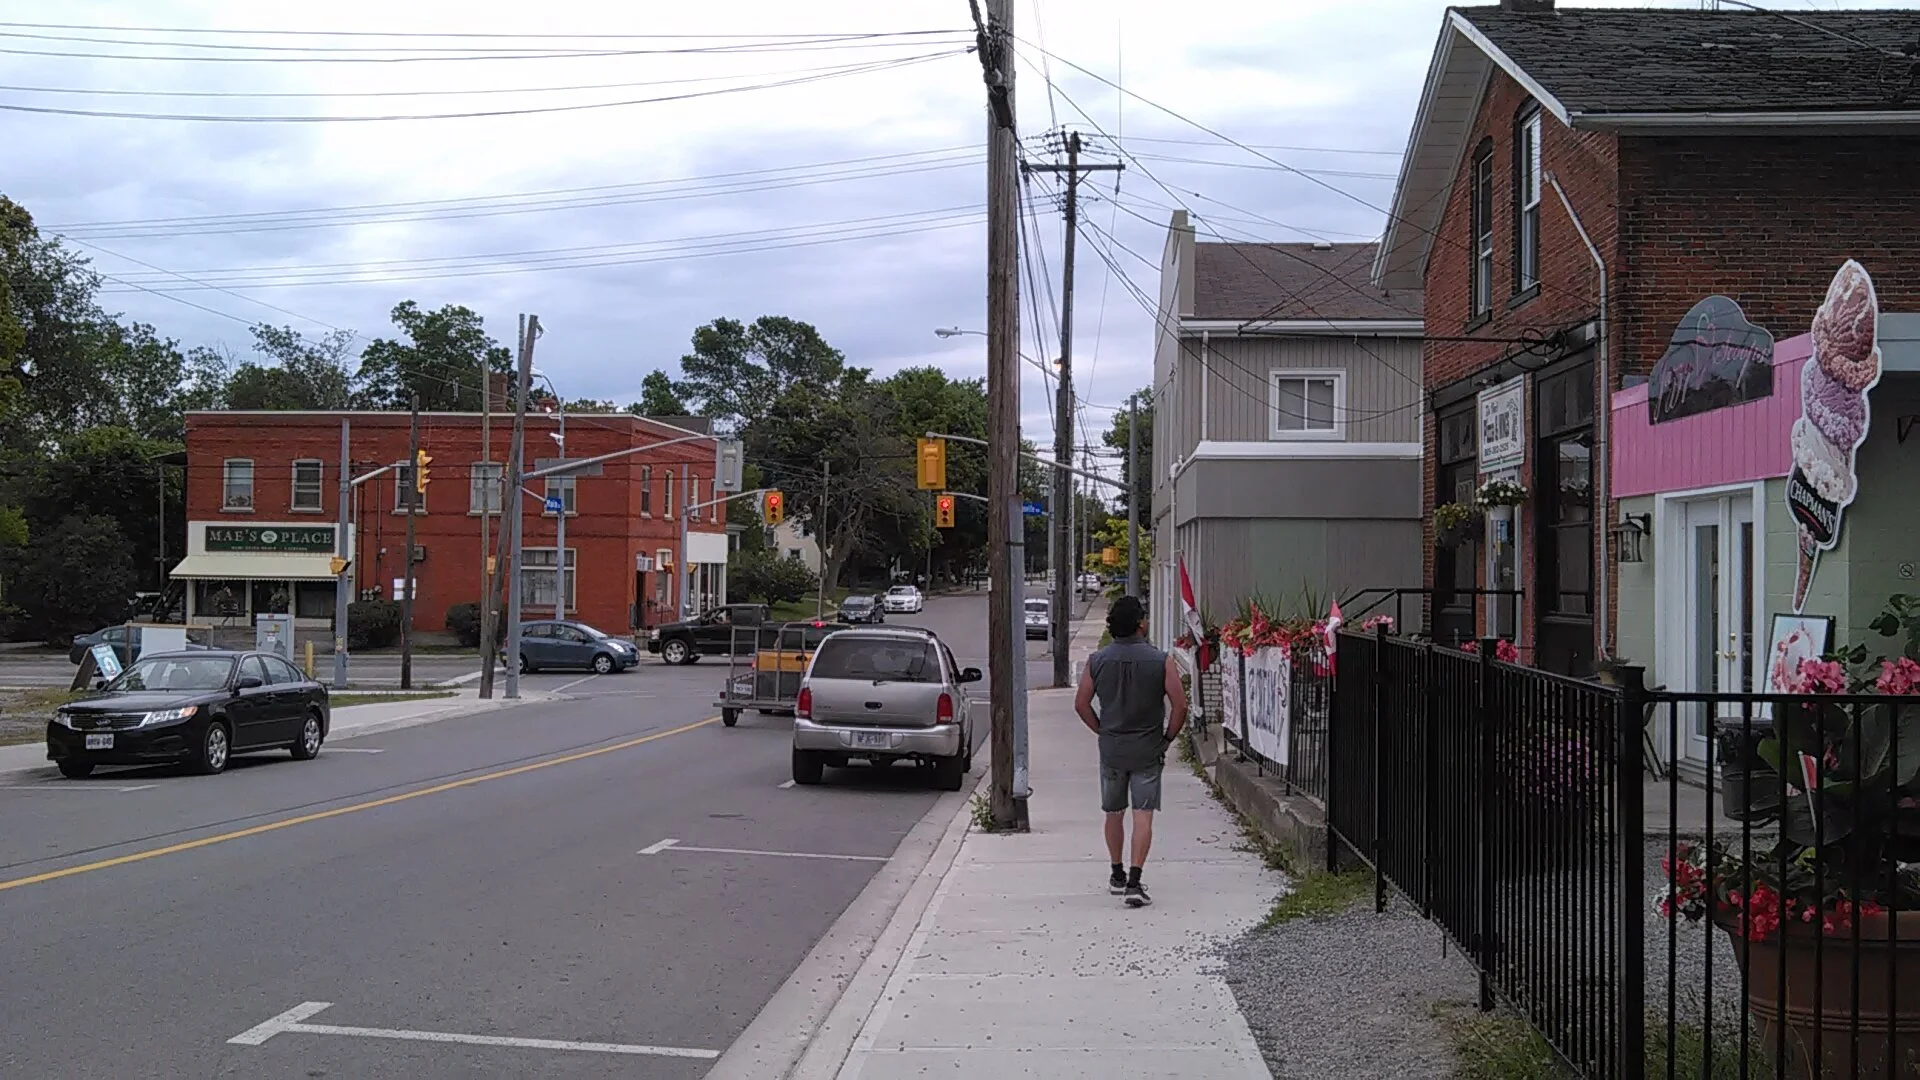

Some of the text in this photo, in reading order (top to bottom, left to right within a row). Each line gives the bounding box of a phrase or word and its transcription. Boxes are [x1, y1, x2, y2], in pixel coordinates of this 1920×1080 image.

[1790, 479, 1836, 535] CHAPMAN'S
[209, 528, 332, 544] MAE'S PLACE
